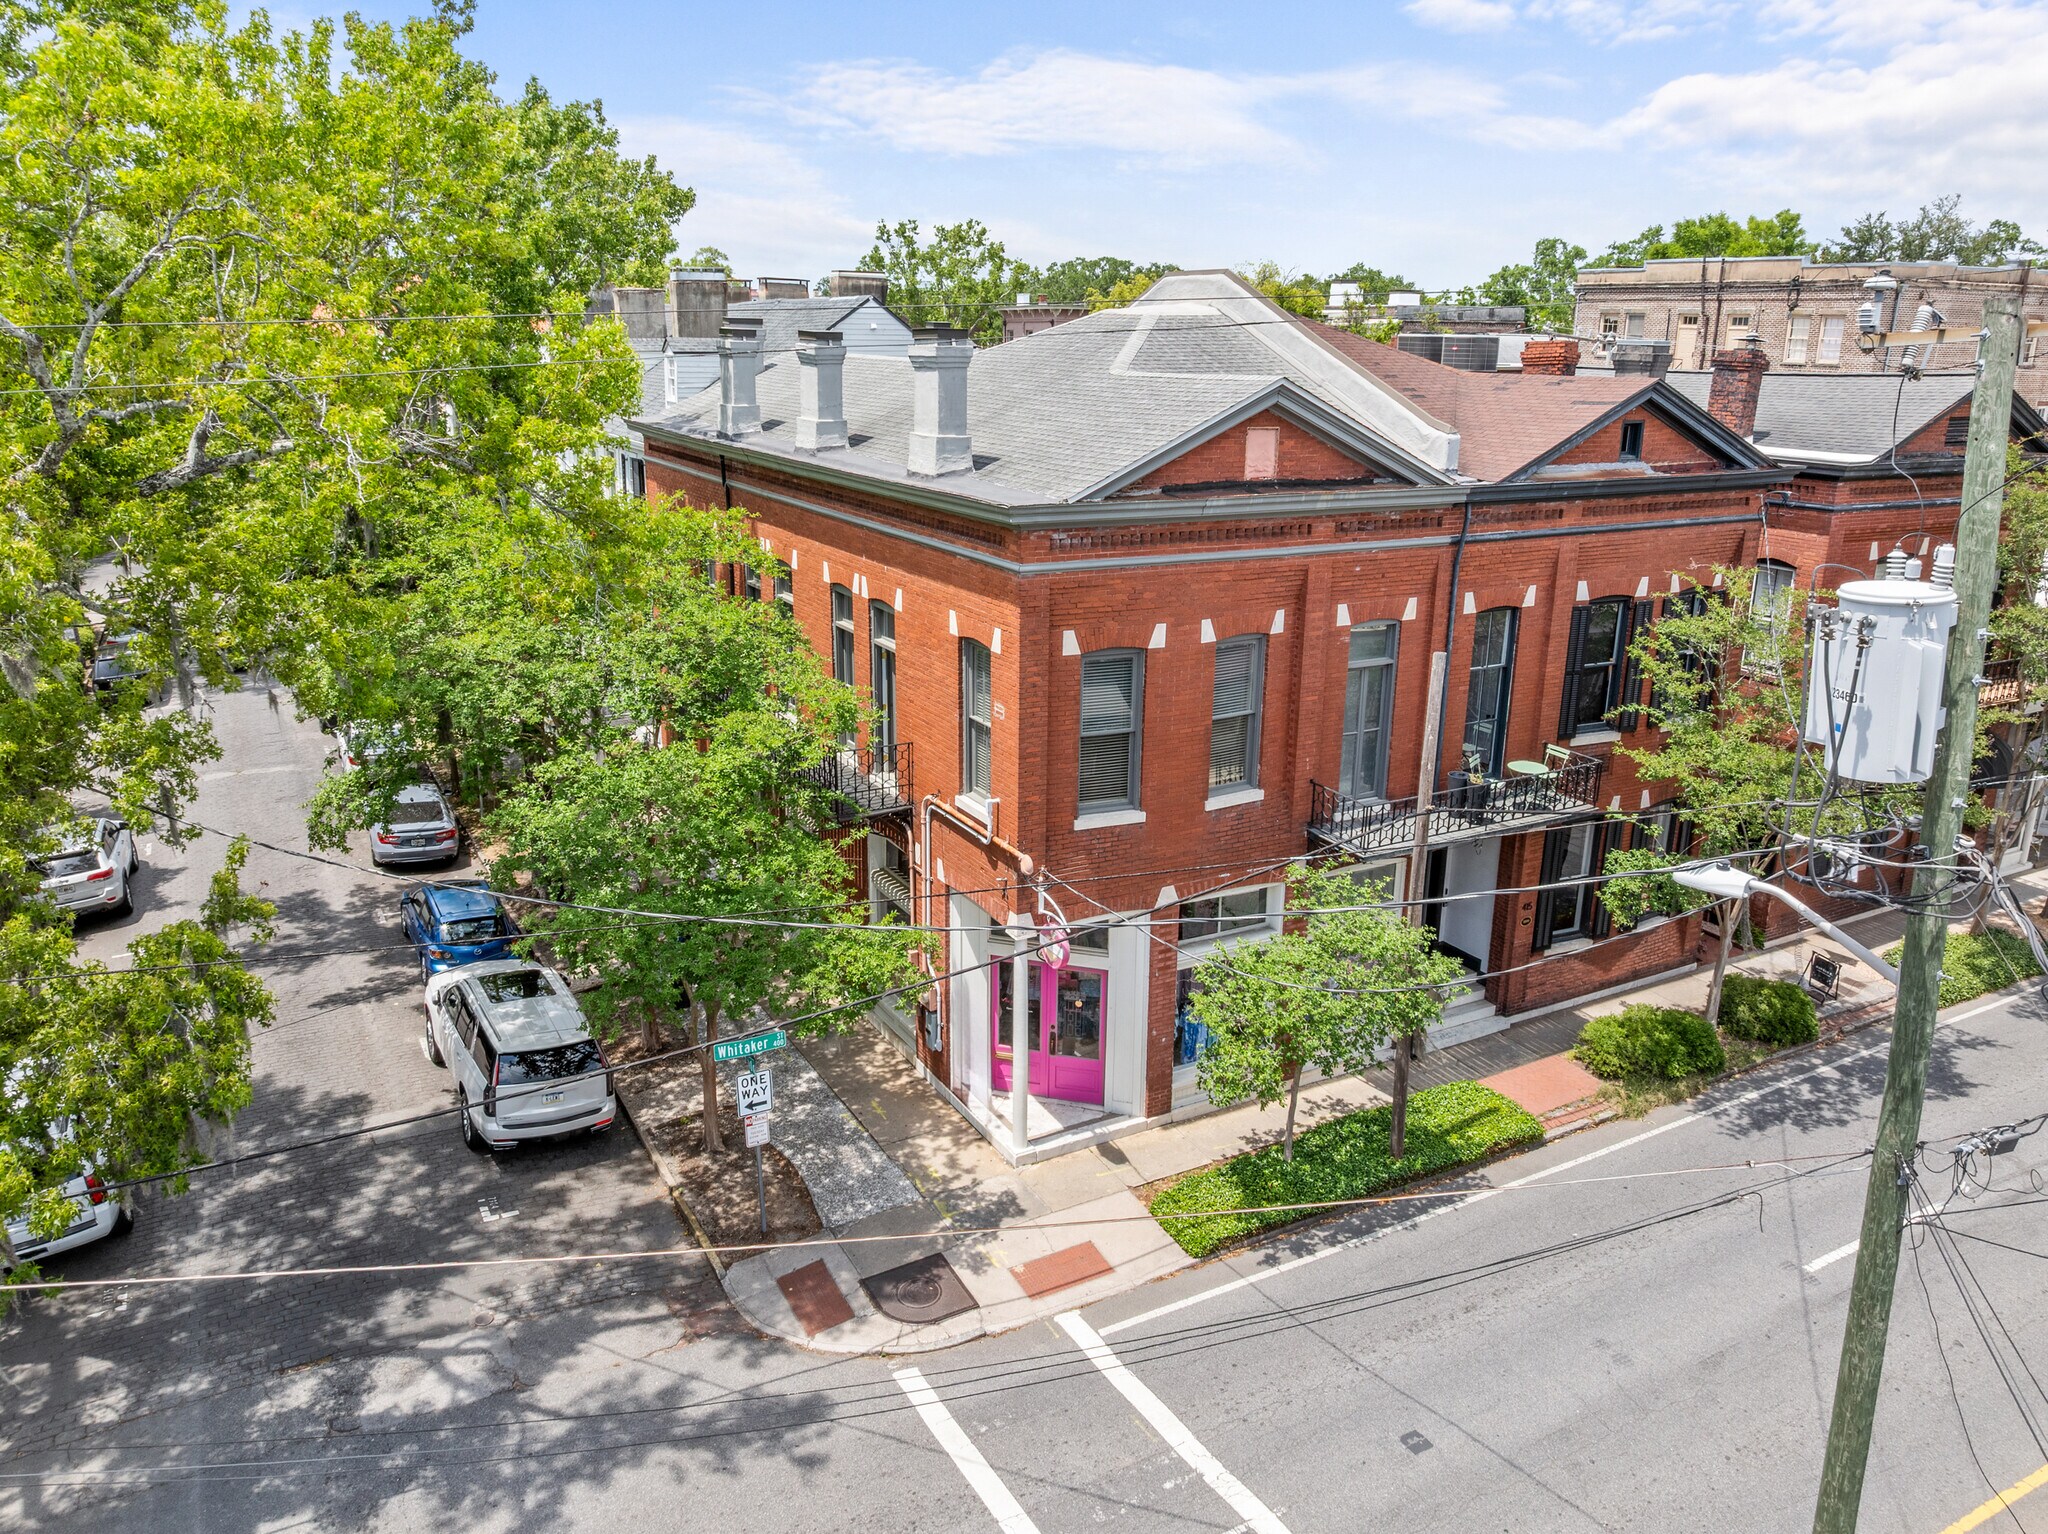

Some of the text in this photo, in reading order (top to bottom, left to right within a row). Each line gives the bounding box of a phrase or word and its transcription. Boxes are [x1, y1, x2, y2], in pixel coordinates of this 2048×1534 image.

[718, 1039, 768, 1058] Whitaker
[741, 1074, 767, 1089] ONE
[741, 1085, 768, 1100] WAY
